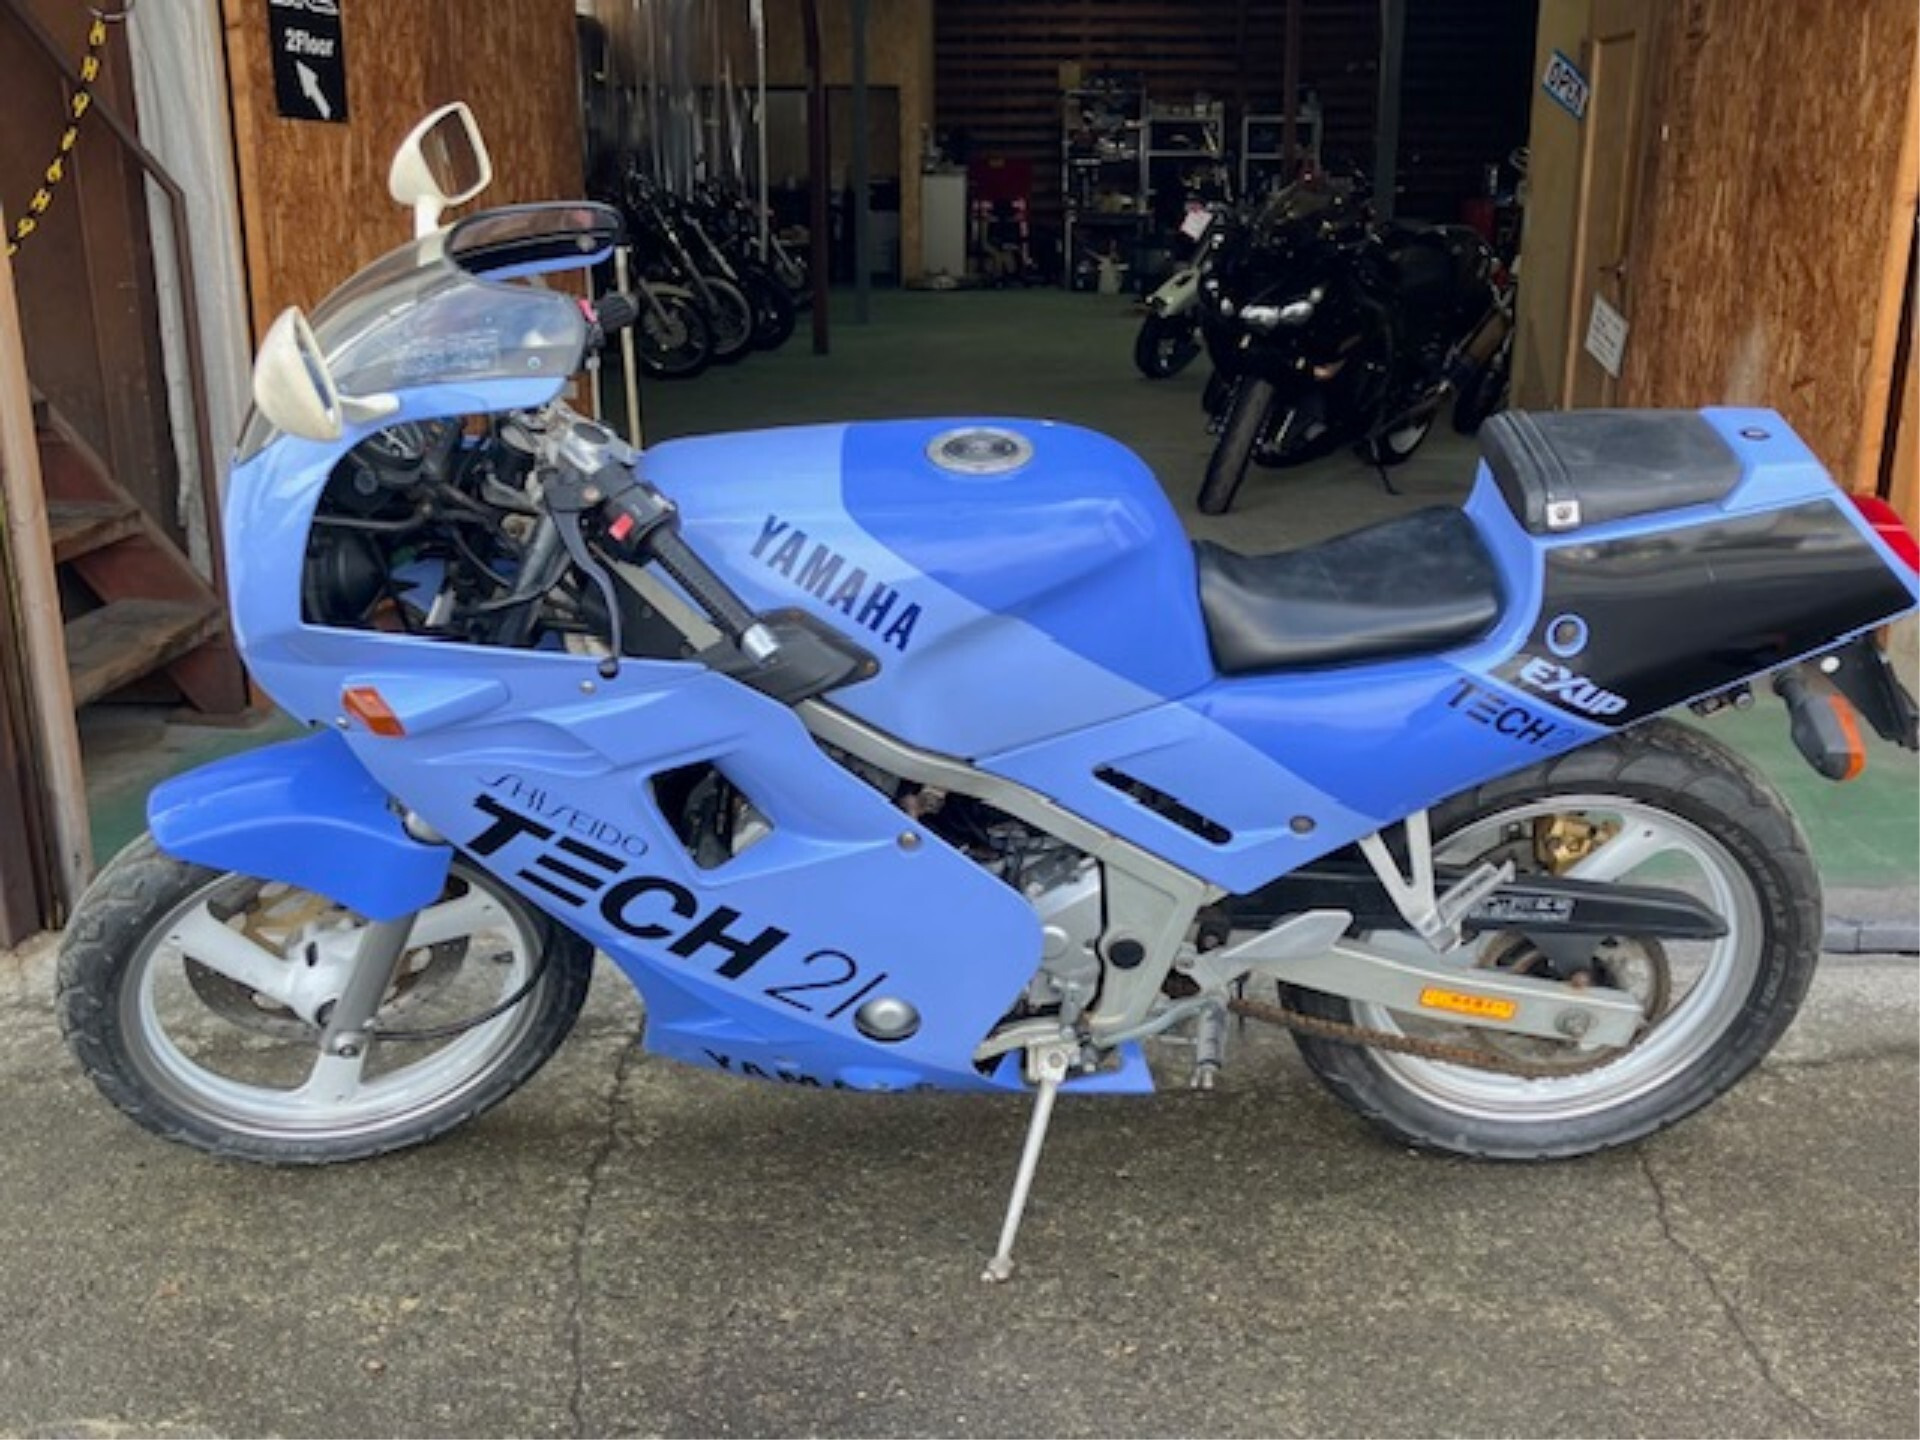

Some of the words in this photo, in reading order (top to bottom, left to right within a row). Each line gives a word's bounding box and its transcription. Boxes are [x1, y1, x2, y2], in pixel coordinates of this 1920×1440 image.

[750, 514, 922, 652] YAMAHA
[1520, 656, 1628, 716] EXUP
[478, 773, 649, 858] SHISEIDO
[465, 793, 790, 980] TECH
[764, 949, 888, 1020] 21
